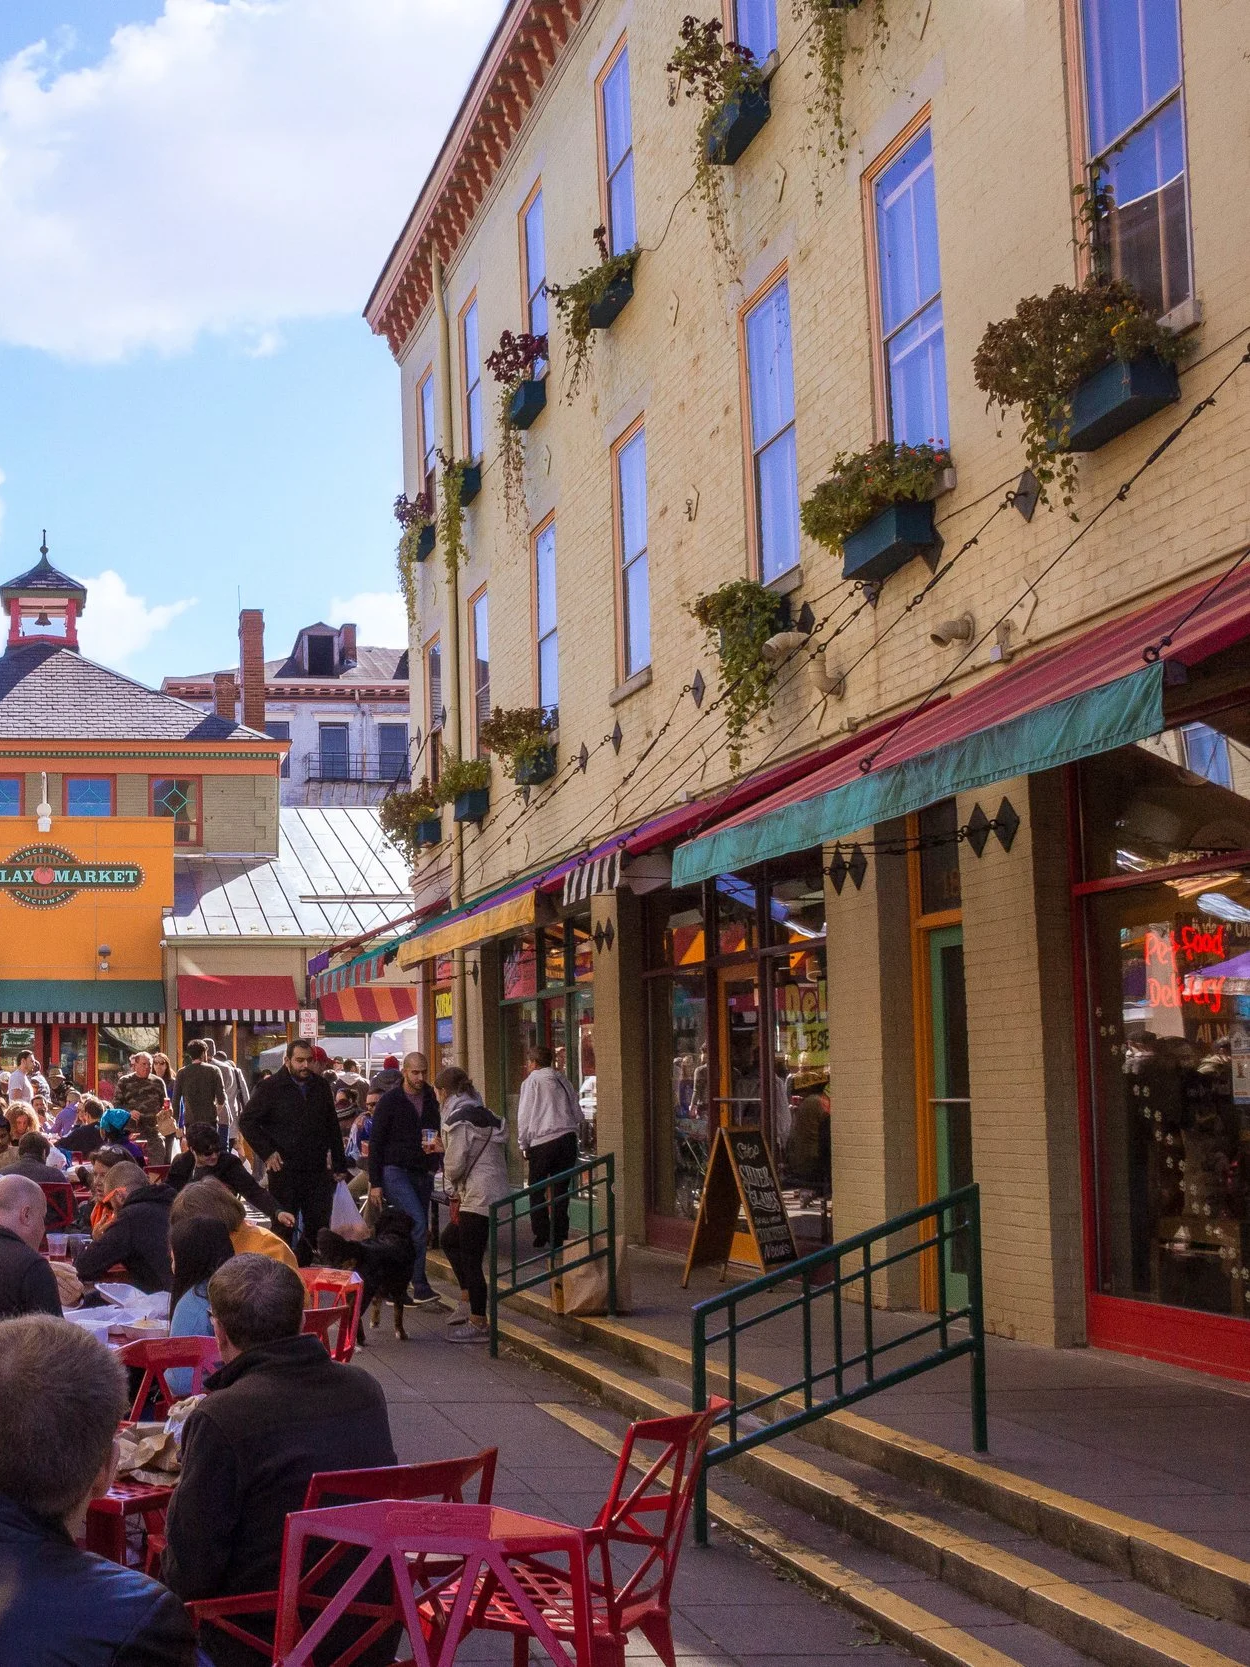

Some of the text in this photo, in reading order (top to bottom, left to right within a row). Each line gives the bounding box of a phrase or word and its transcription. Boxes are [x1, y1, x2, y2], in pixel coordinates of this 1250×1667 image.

[15, 848, 43, 862] SINCE
[53, 870, 138, 883] MARKET
[15, 890, 70, 905] CINCINNATI
